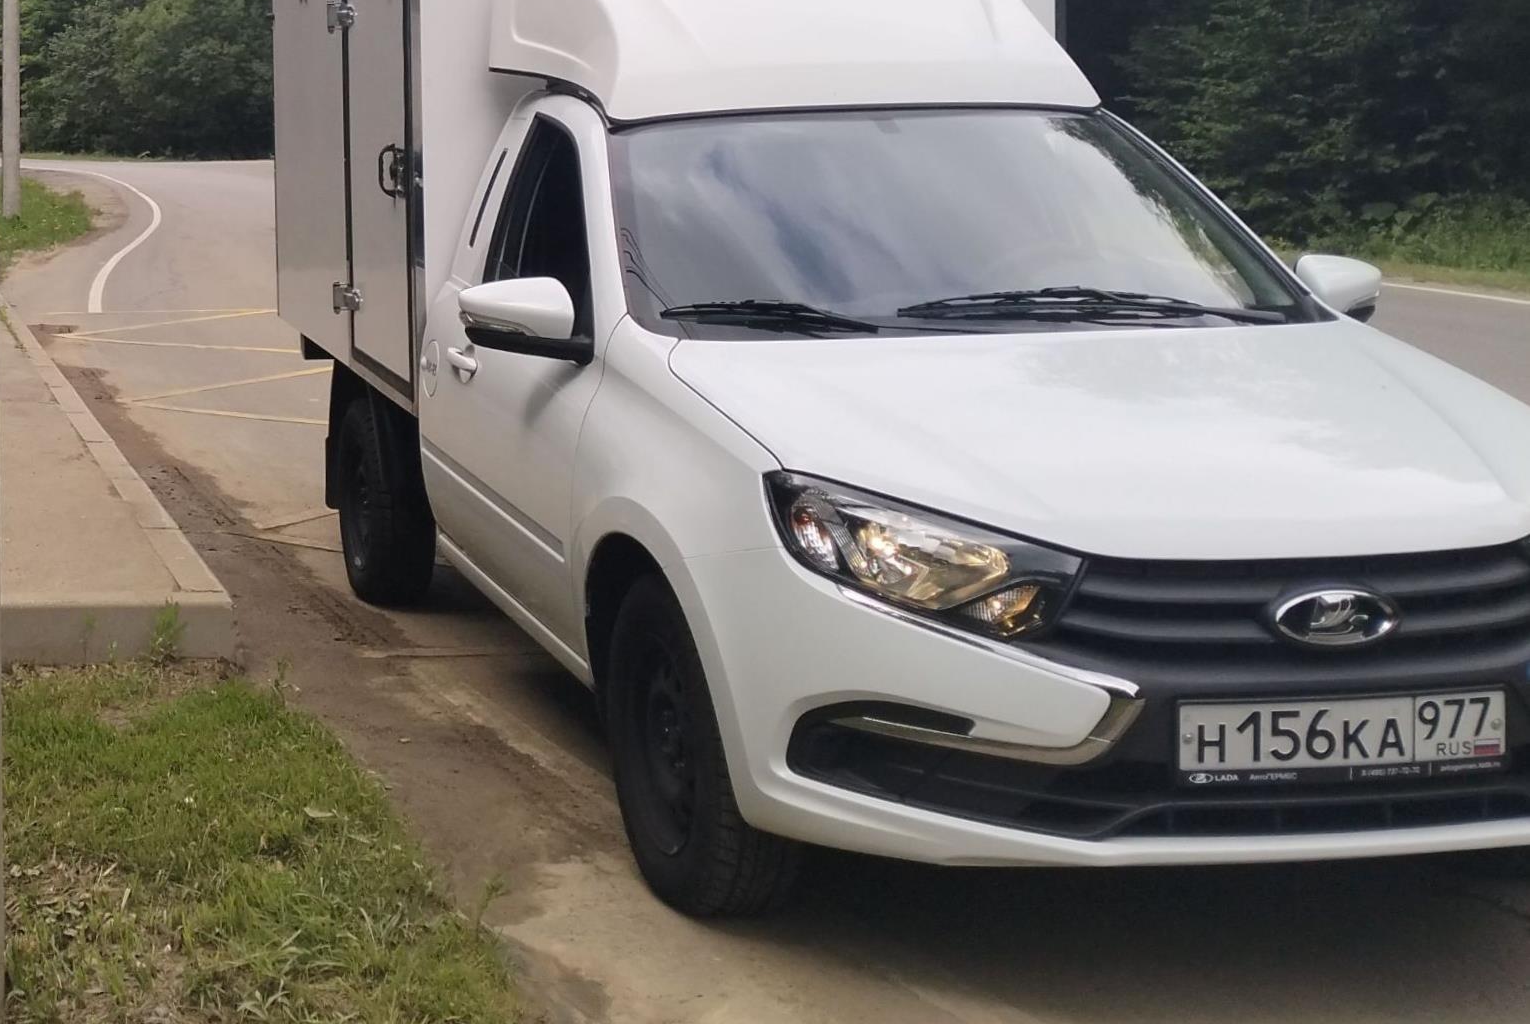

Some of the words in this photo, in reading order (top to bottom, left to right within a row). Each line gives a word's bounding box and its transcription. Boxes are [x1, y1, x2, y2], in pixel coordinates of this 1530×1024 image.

[1197, 708, 1406, 763] Н156КА
[1417, 696, 1491, 740] 977
[1436, 741, 1472, 756] RUS
[1215, 773, 1239, 782] LADA
